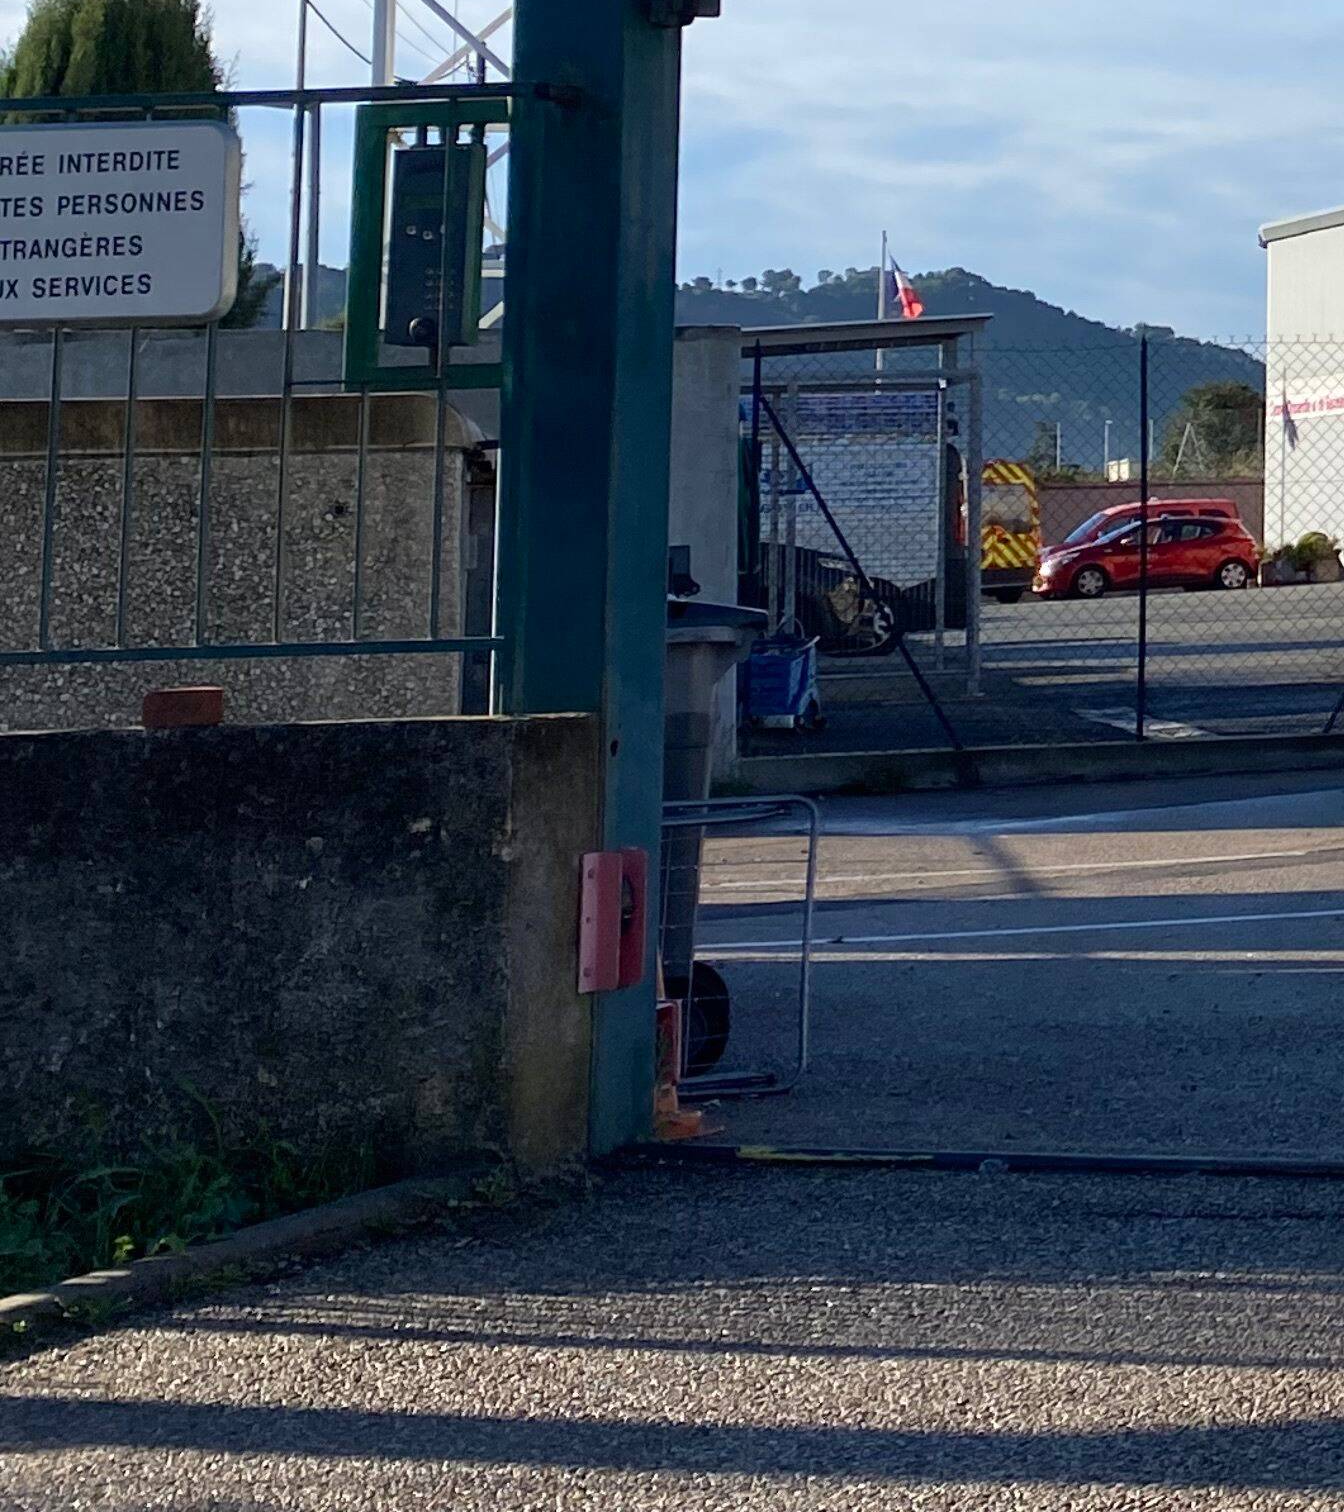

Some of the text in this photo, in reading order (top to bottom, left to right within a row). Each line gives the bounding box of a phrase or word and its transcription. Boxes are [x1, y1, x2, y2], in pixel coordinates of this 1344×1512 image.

[0, 150, 180, 175] RÉE INTERDITE
[0, 190, 205, 218] TES PERSONNES
[32, 274, 152, 299] SERVICES
